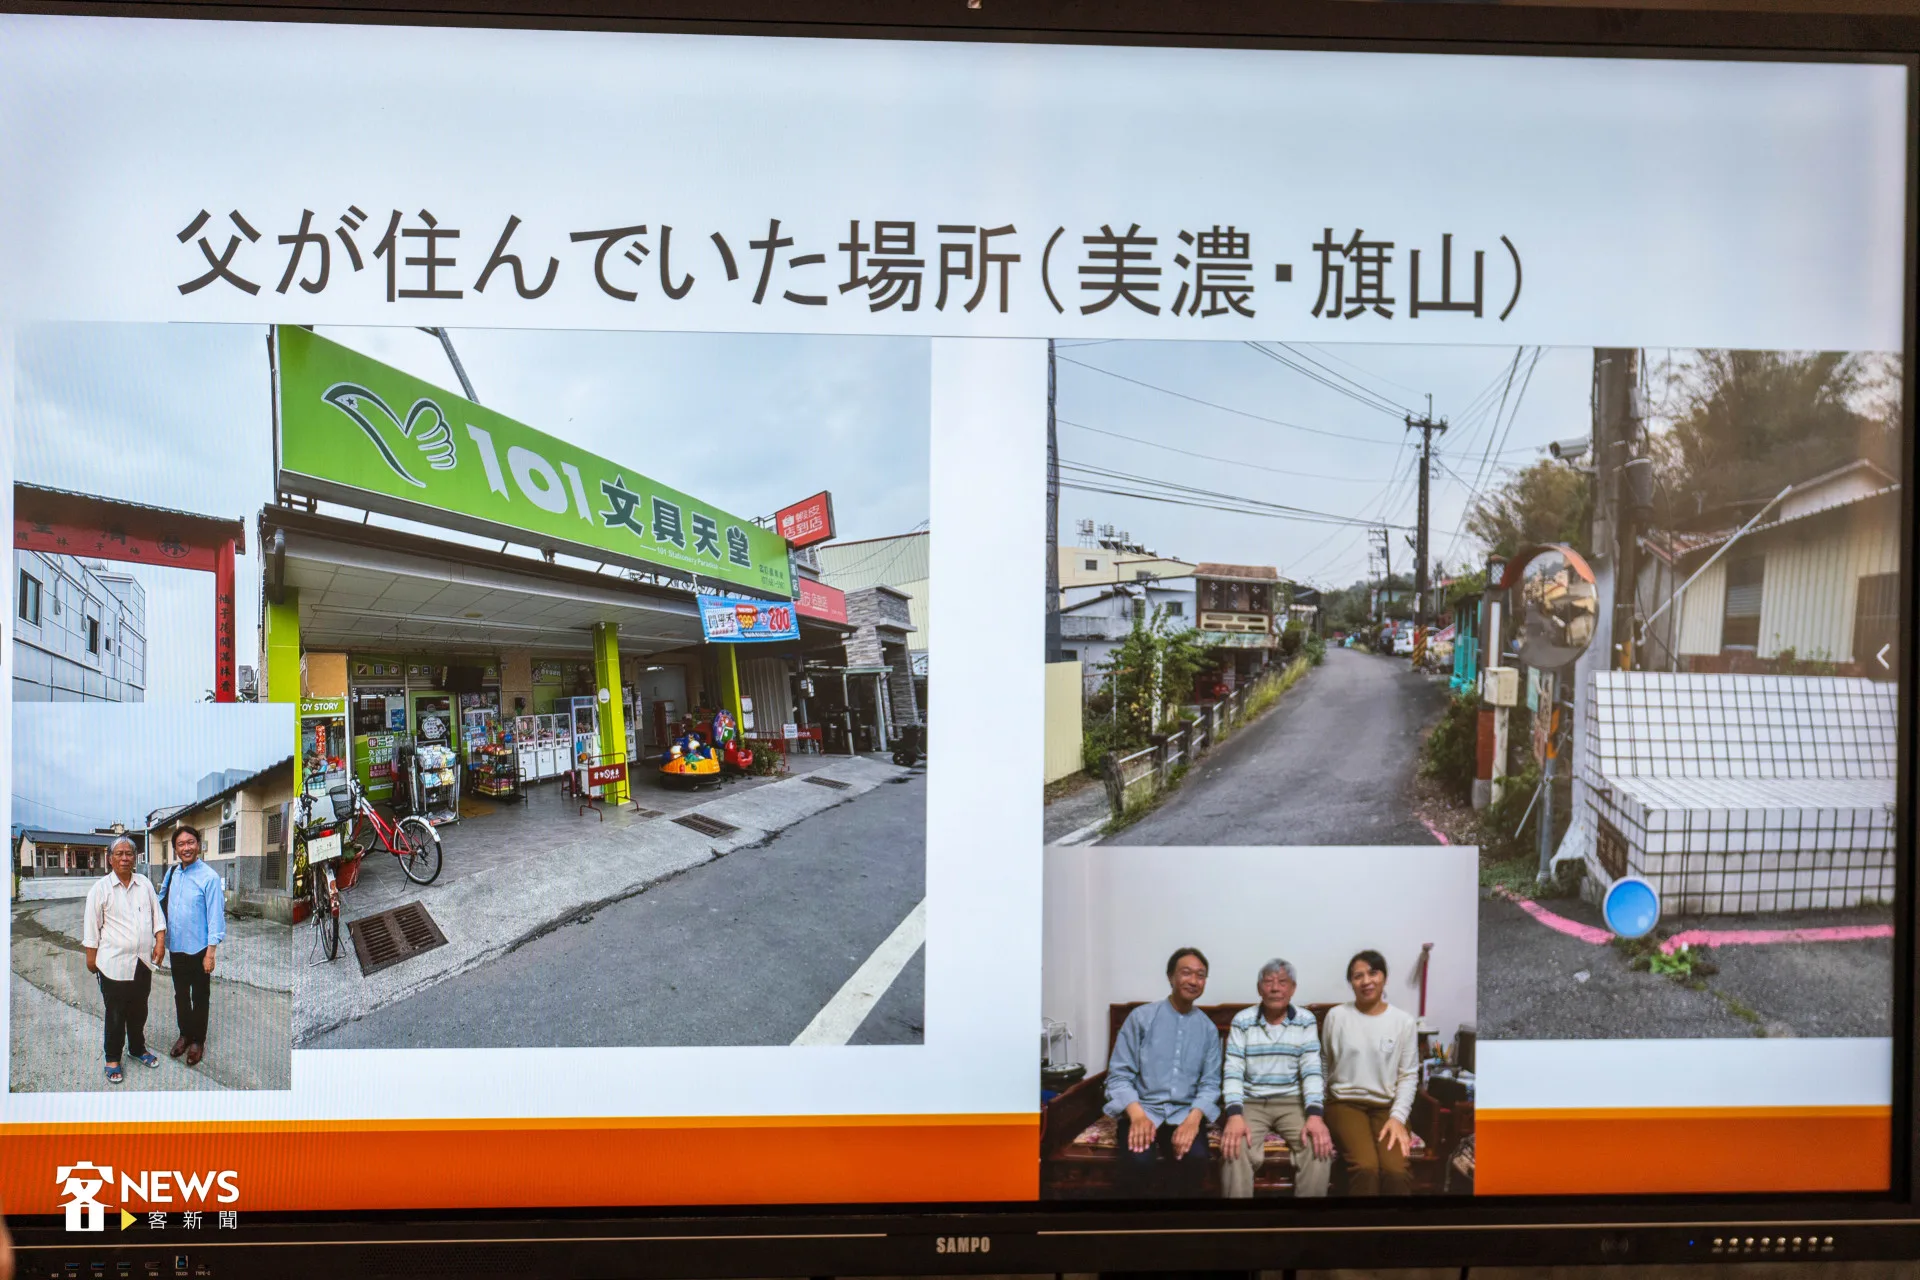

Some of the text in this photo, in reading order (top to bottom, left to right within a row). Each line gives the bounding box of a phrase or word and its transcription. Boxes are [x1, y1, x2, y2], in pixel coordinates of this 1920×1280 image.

[176, 204, 1523, 322] 父が住んでいた場所（美濃・旗山）
[465, 422, 752, 569] 101 文具天堂
[767, 606, 791, 632] 200
[300, 702, 339, 711] OY STORY
[935, 1236, 991, 1254] SAMPO
